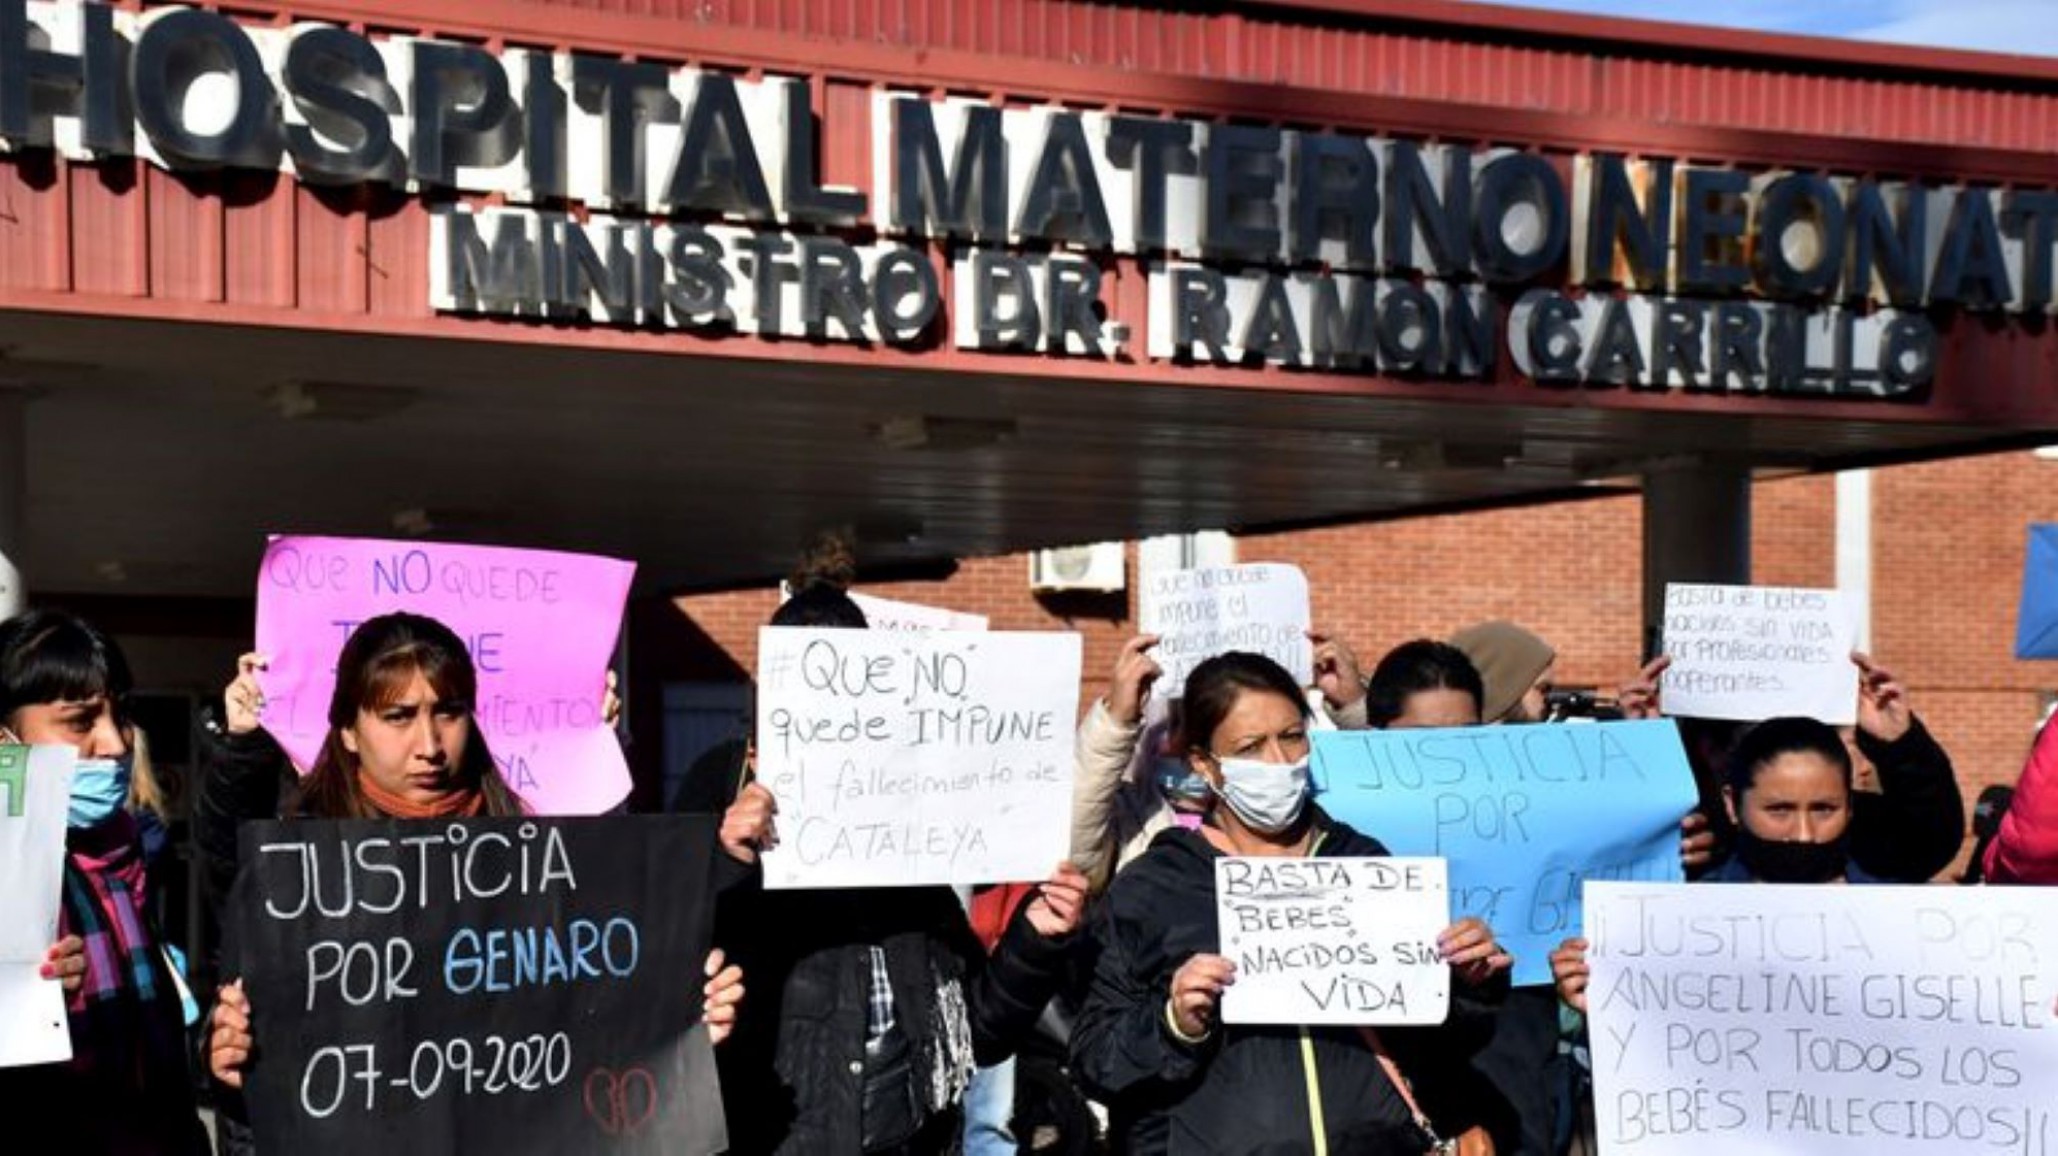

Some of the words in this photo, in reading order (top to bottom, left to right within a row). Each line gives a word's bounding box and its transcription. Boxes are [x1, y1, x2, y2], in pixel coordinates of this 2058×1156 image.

[0, 0, 866, 218] HOSPITAL
[886, 94, 1568, 282] MATERNO
[1584, 152, 2058, 310] NEONAT
[446, 210, 939, 342] MINISTRO
[972, 250, 1129, 356] DR.
[1169, 264, 1493, 374] RAMON
[1512, 292, 1936, 396] CARRILLO
[372, 550, 432, 595] NO
[440, 561, 562, 606] QUEDE
[770, 708, 891, 757] quede
[908, 704, 1056, 747] IMPUNE
[774, 757, 805, 804] el
[827, 758, 1012, 812] fallecimiento
[1026, 761, 1061, 784] de
[1435, 792, 1530, 857] POR
[1221, 861, 1353, 898] BASTA
[306, 936, 418, 1010] POR
[444, 918, 639, 993] GENARO
[1915, 906, 2040, 965] POR
[1601, 966, 1844, 1016] ANGELINE
[1860, 974, 2045, 1030] GISELLE
[301, 1031, 571, 1117] 07-09-2020
[1609, 1021, 1637, 1074] Y
[1666, 1022, 1761, 1073] POR
[1786, 1027, 1923, 1081] TODOS
[1940, 1046, 2023, 1089] LOS
[1613, 1077, 1748, 1146] BEBÉS
